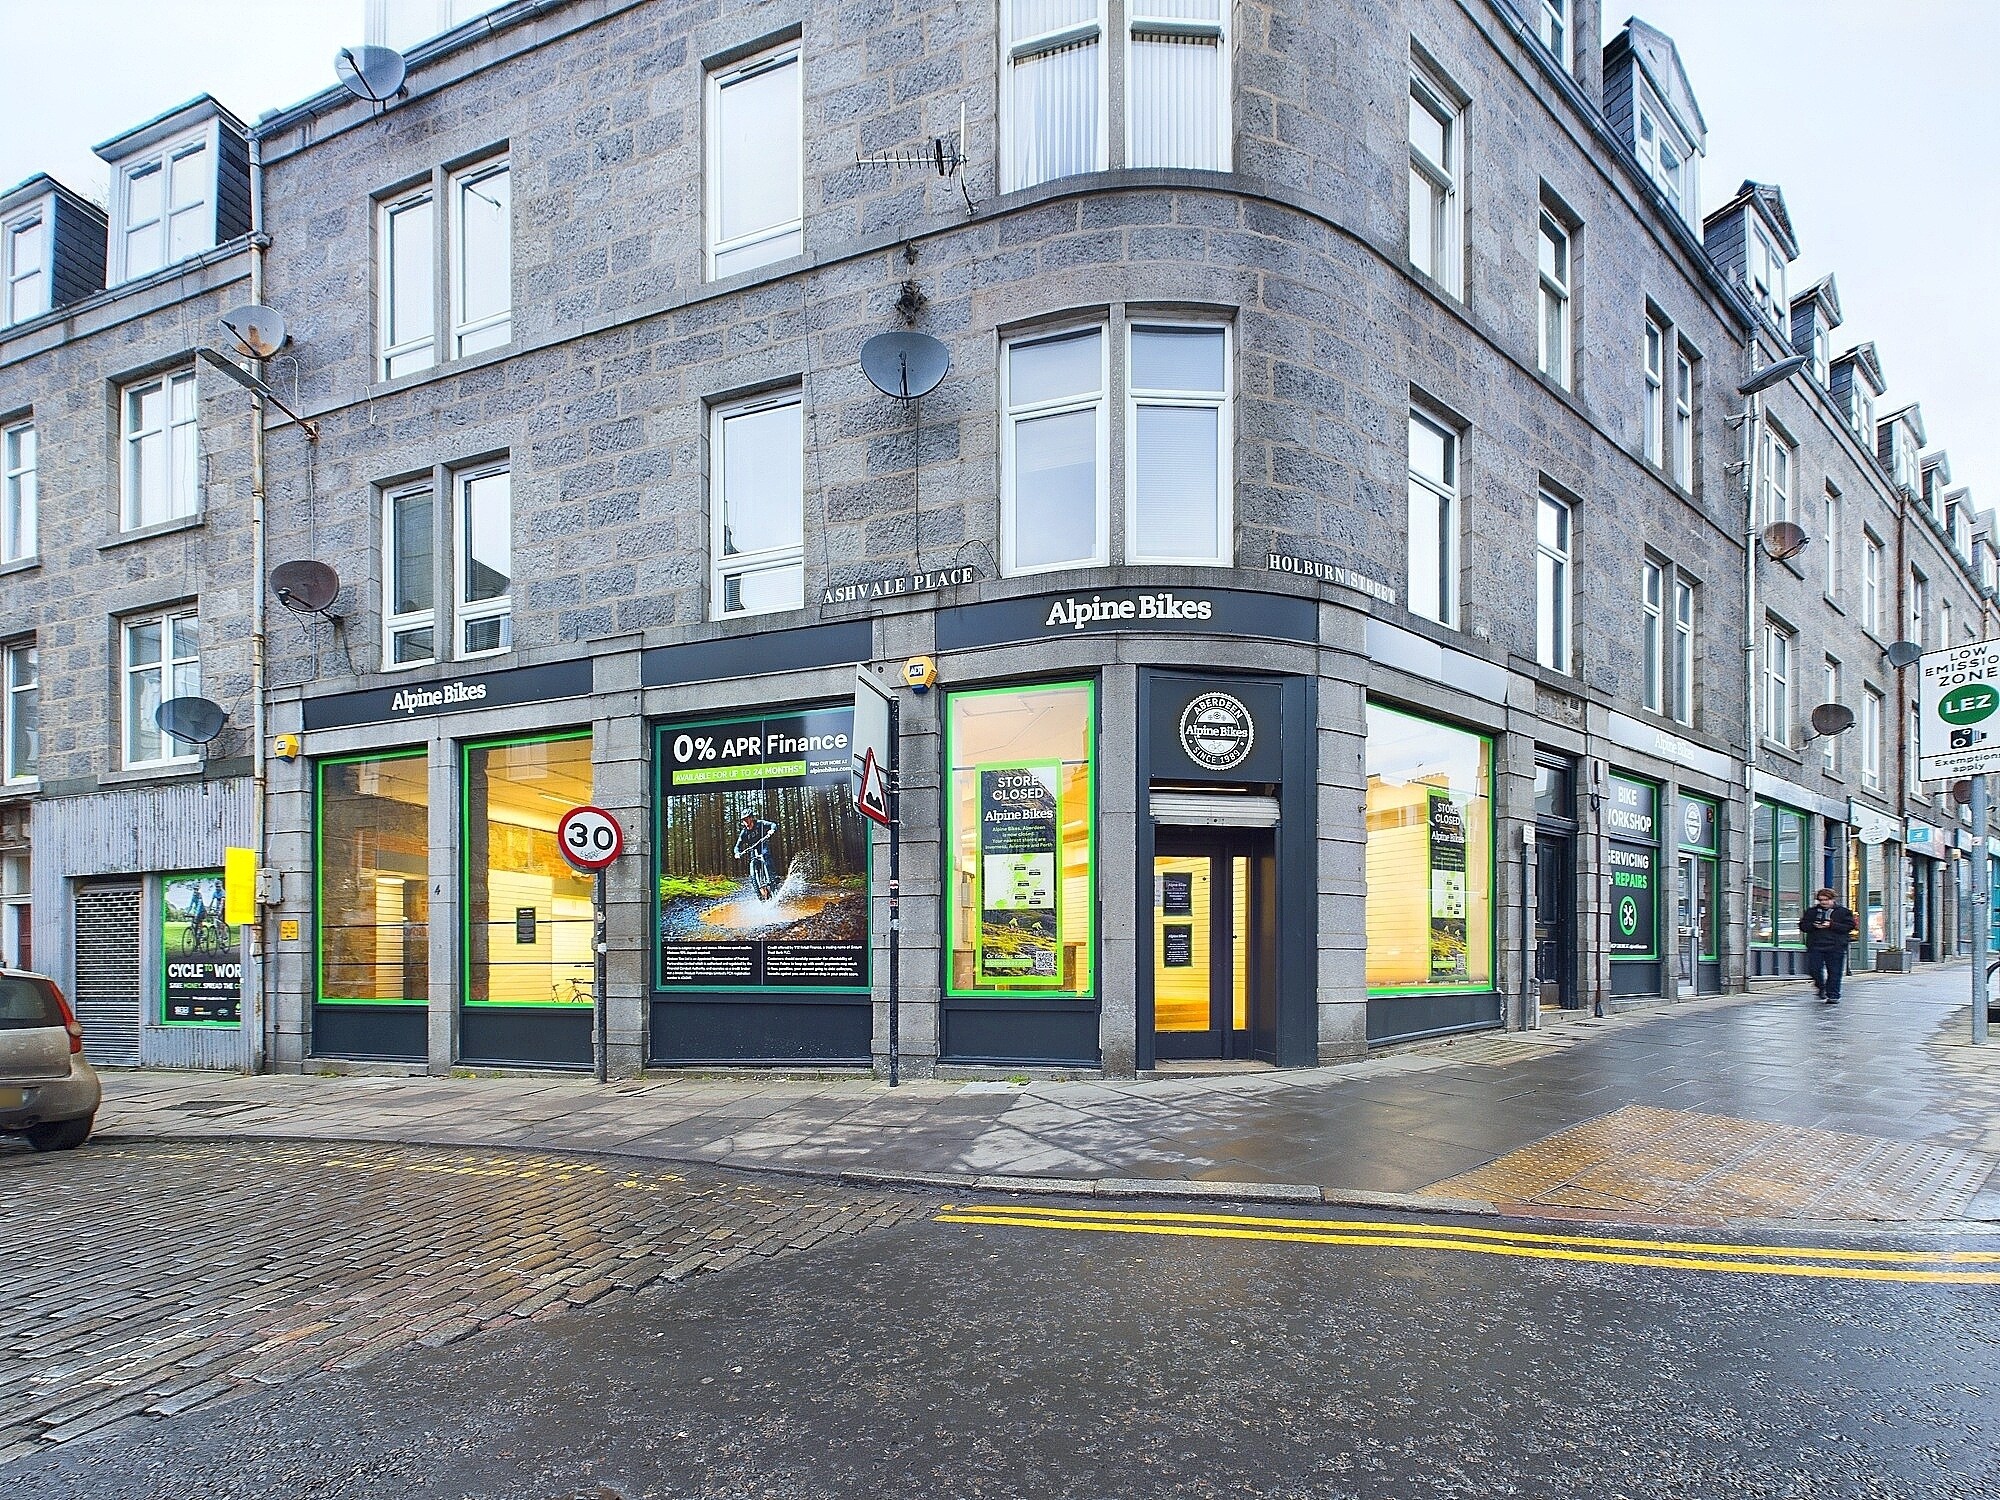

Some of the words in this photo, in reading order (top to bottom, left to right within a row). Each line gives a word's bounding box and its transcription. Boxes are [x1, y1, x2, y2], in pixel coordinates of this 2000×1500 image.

[823, 578, 906, 603] ASHVALE
[913, 568, 973, 591] PLACE
[1269, 553, 1346, 584] HOLBURN
[1350, 572, 1396, 604] STREET
[1046, 595, 1136, 629] Alpine
[1138, 593, 1212, 619] Bikes
[1950, 646, 1988, 661] LOW
[910, 665, 924, 676] ADT
[1925, 654, 2000, 677] EMISSIO
[1939, 667, 1999, 687] ZONE
[391, 687, 443, 714] Alpine
[443, 682, 487, 704] Bikes
[1945, 694, 1992, 714] LEZ
[1193, 697, 1244, 719] ABERDEEN
[1185, 724, 1220, 738] Alpine
[1219, 725, 1249, 737] Bikes
[673, 734, 717, 763] 0%
[721, 736, 762, 759] APR
[766, 733, 848, 755] Finance
[1192, 746, 1217, 764] SINCE
[1219, 749, 1241, 764] 1989
[676, 772, 711, 782] AVAILABLE
[713, 770, 728, 779] FOR
[741, 768, 751, 777] TO
[1952, 763, 1985, 773] apply
[998, 776, 1039, 787] STORE
[993, 788, 1044, 800] CLOSED
[1617, 785, 1638, 806] BIKE
[984, 809, 1021, 823] Alpine
[1021, 807, 1054, 820] Bikes
[1436, 814, 1460, 825] CLOSED
[568, 822, 614, 851] 30
[1615, 871, 1648, 889] REPAIRS
[168, 963, 204, 978] CYCLE
[204, 963, 214, 972] TO
[213, 963, 241, 978] WOR
